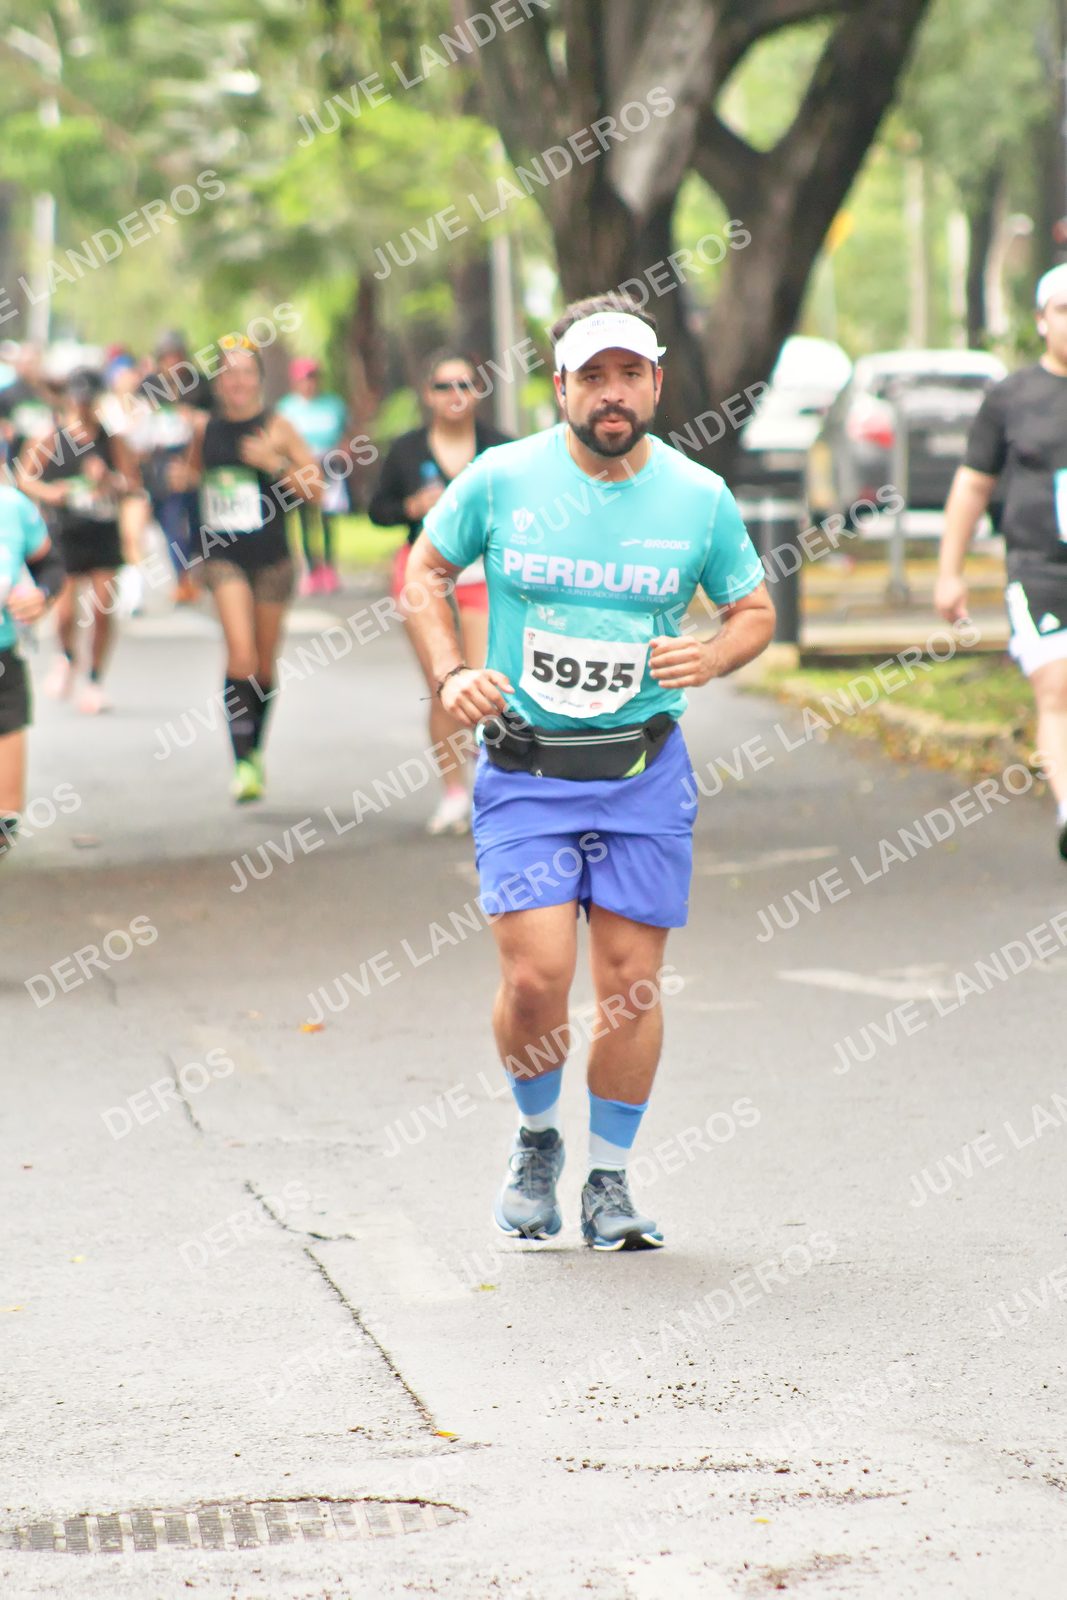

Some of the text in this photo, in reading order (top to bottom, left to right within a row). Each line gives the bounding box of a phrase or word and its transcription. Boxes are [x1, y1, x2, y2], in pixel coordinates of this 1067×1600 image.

[643, 538, 690, 551] BROOKS
[503, 547, 680, 596] PERDURA
[532, 650, 635, 693] 5935
